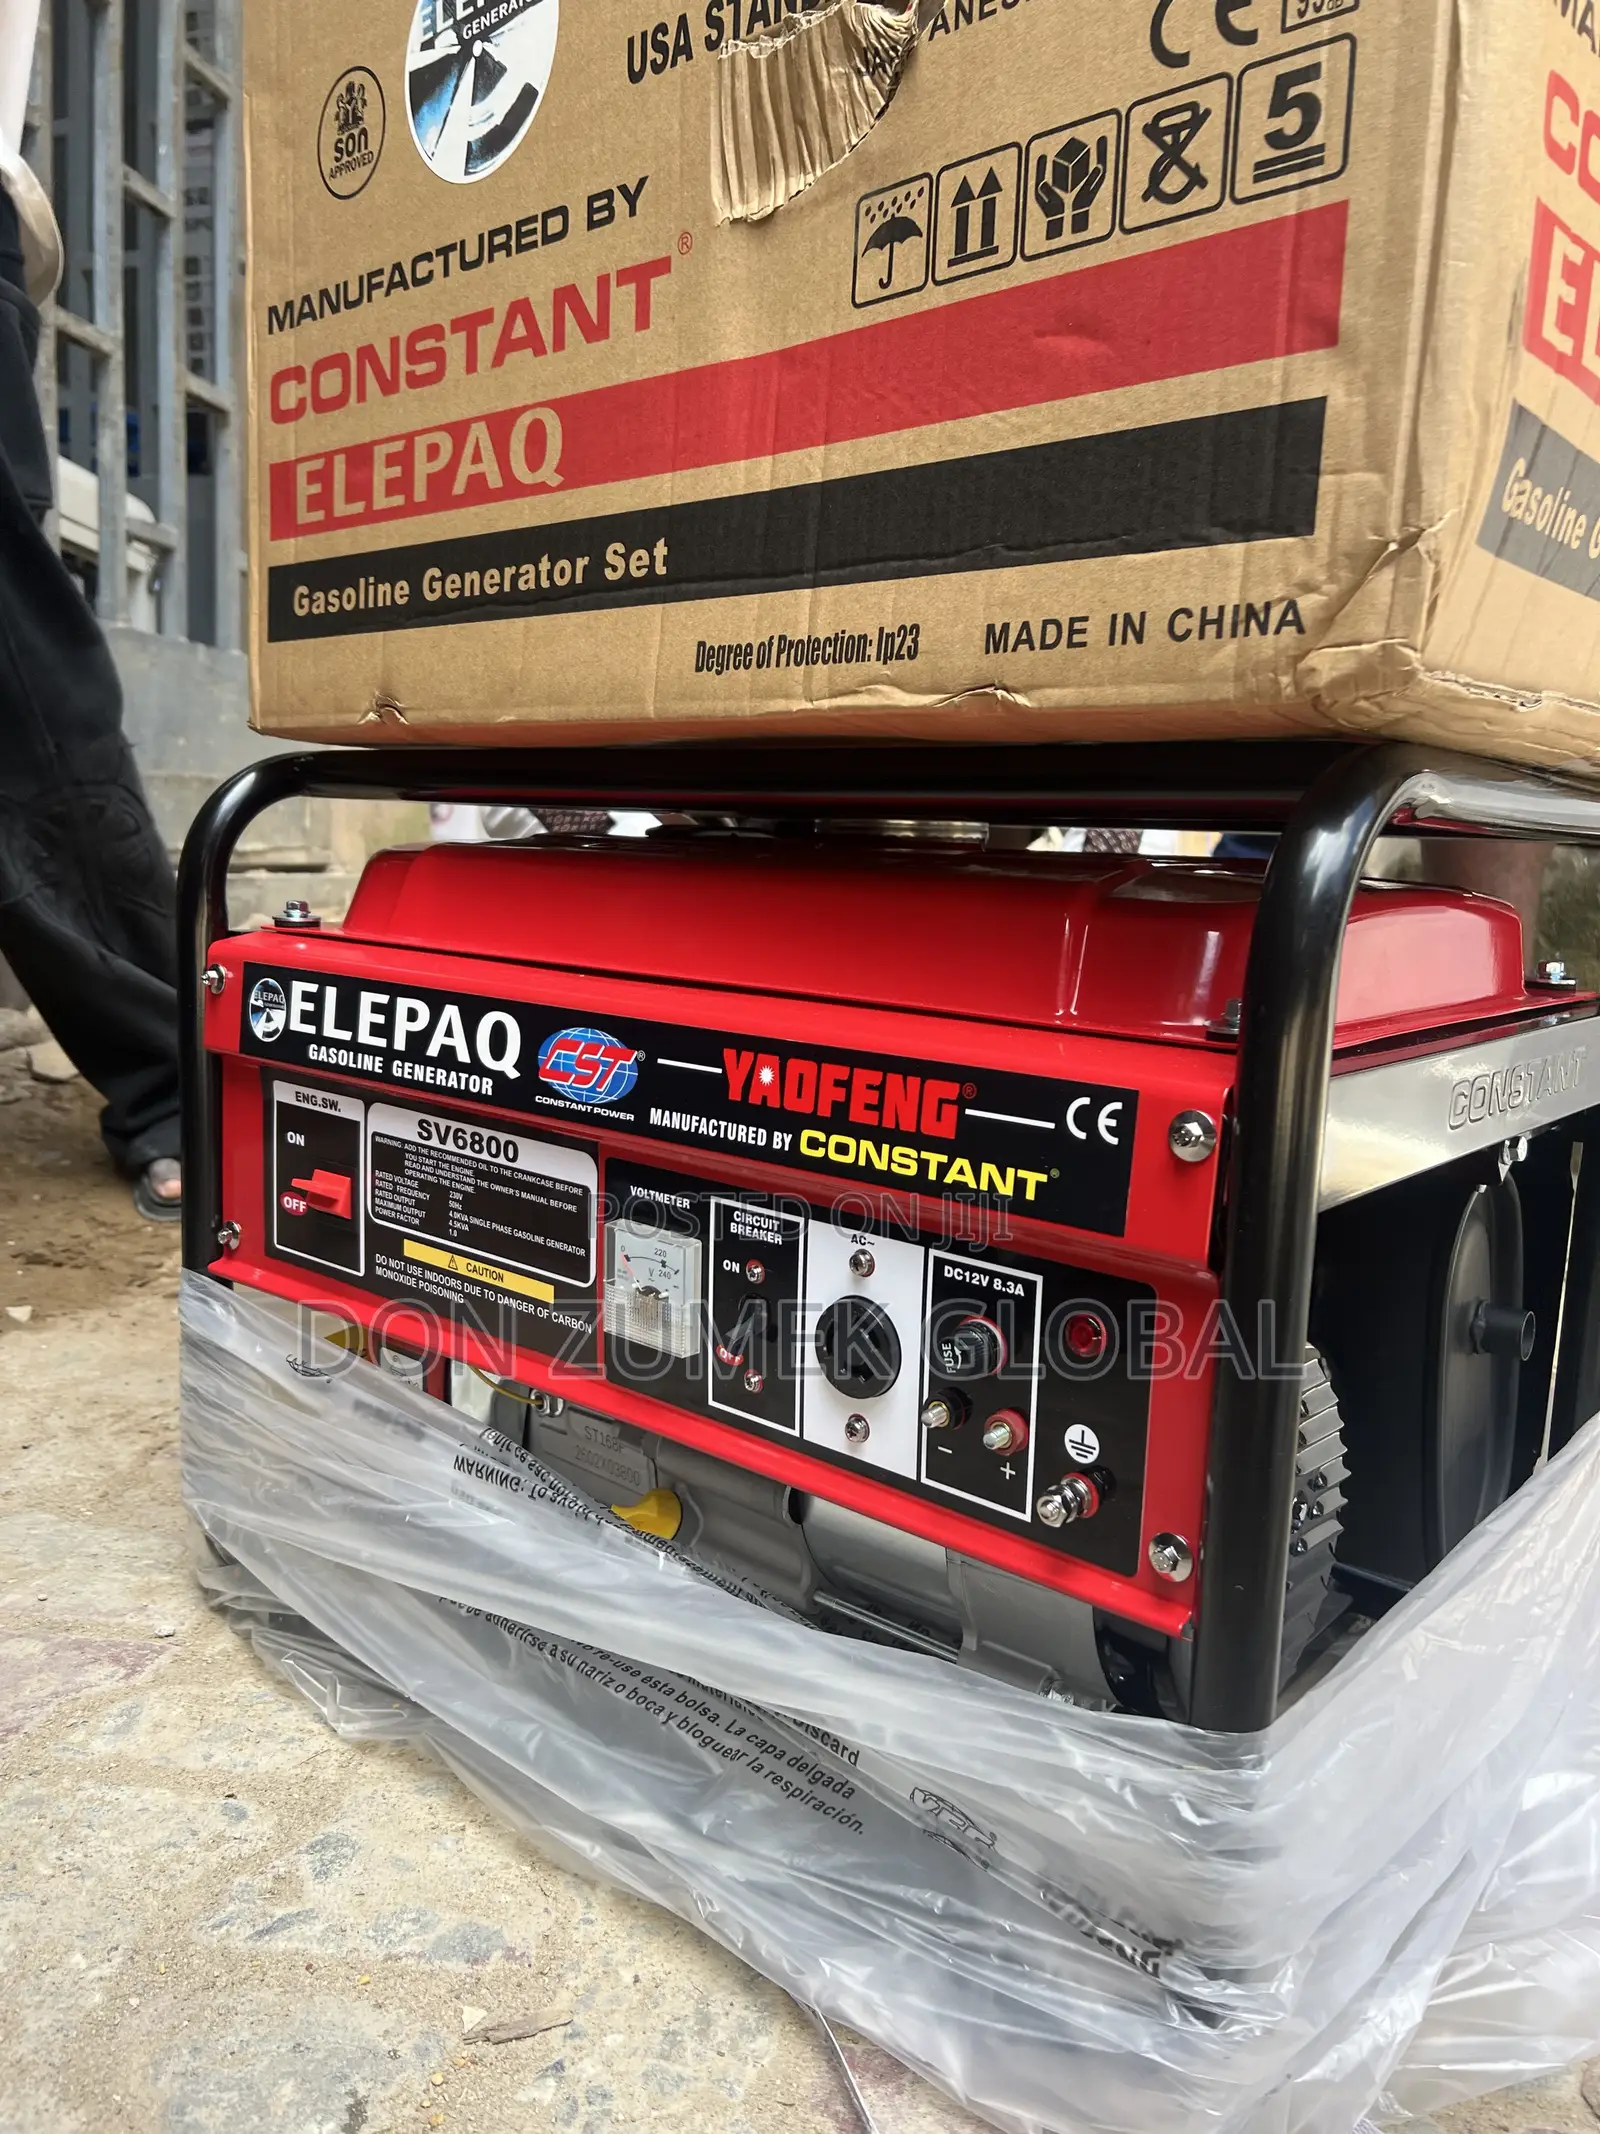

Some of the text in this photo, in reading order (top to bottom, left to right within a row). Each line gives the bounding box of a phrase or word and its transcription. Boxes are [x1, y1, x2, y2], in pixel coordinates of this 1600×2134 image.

[627, 0, 822, 84] USA STAN
[1264, 61, 1322, 149] 5
[329, 150, 374, 180] APPROVED
[267, 176, 649, 335] MANUFACTURED BY
[296, 406, 565, 526] ELEPAQ
[1502, 457, 1587, 549] Gasoline
[293, 537, 669, 618] Gasoline Generator Set
[984, 600, 1307, 655] MADE IN CHINA
[694, 640, 753, 675] Degree
[757, 637, 774, 670] of
[776, 628, 873, 668] Protection:
[289, 980, 521, 1080] ELEPAQ
[308, 1043, 493, 1096] GASOLINE GENERATOR
[538, 1038, 637, 1092] CST
[294, 1091, 342, 1113] ENG.SW.
[1448, 1045, 1588, 1131] CONSTANT
[287, 1131, 305, 1147] ON
[416, 1118, 519, 1164] SV6800
[649, 1107, 767, 1147] MANUFACTURED
[773, 1131, 793, 1152] BY
[1066, 1096, 1123, 1145] CE
[375, 1170, 393, 1181] RATED
[394, 1175, 419, 1188] VOLTAGE
[404, 1143, 417, 1152] ADD
[418, 1147, 429, 1156] THE
[430, 1150, 477, 1168] RECOMMENDED
[478, 1162, 489, 1171] OIL
[490, 1165, 499, 1174] TO
[500, 1168, 512, 1177] THE
[513, 1171, 554, 1189] CRANKCASE
[555, 1182, 583, 1196] BEFORE
[405, 1153, 418, 1161] YOU
[418, 1156, 437, 1166] START
[439, 1161, 450, 1170] THE
[405, 1169, 438, 1183] OPERATING
[439, 1177, 450, 1186] THE
[284, 1196, 307, 1214] OFF
[375, 1179, 462, 1210] RATED FREQUENCY 50Hz
[375, 1198, 402, 1211] MAXIMUM
[403, 1206, 426, 1218] OUTPUT
[405, 1160, 577, 1212] READ AND UNDERSTAND THE OWNER'S MANUAL BEFORE
[629, 1185, 691, 1209] VOLTMETER
[375, 1206, 396, 1218] POWER
[397, 1213, 420, 1225] FACTOR
[375, 1189, 393, 1200] RATED
[394, 1193, 415, 1206] OUTPUT
[469, 1216, 491, 1229] SINGLE
[492, 1222, 512, 1235] PHASE
[513, 1229, 545, 1245] GASOLINE
[546, 1239, 586, 1256] GENERATOR
[730, 1222, 783, 1245] BREAKER
[733, 1211, 780, 1232] CIRCUIT
[466, 1262, 504, 1283] CAUTION
[654, 1247, 667, 1258] 220
[658, 1269, 672, 1280] 240
[722, 1259, 740, 1274] ON
[375, 1266, 464, 1304] MONOXIDE POISONING
[375, 1254, 592, 1334] DO NOT USE INDOORS DUE TO DANGER OF CARBON
[944, 1265, 1025, 1297] DC12V 8.3A
[942, 1342, 956, 1374] FUSE
[560, 1648, 578, 1668] su
[576, 1658, 616, 1688] nariz
[614, 1682, 627, 1695] o
[625, 1686, 666, 1717] boca
[661, 1711, 679, 1726] y
[746, 1756, 765, 1774] la
[763, 1769, 864, 1835] respiración.
[593, 1647, 642, 1679] re-use
[675, 1690, 721, 1728] bolsa.
[724, 1719, 747, 1737] La
[746, 1734, 787, 1761] capa
[787, 1755, 856, 1800] delgada
